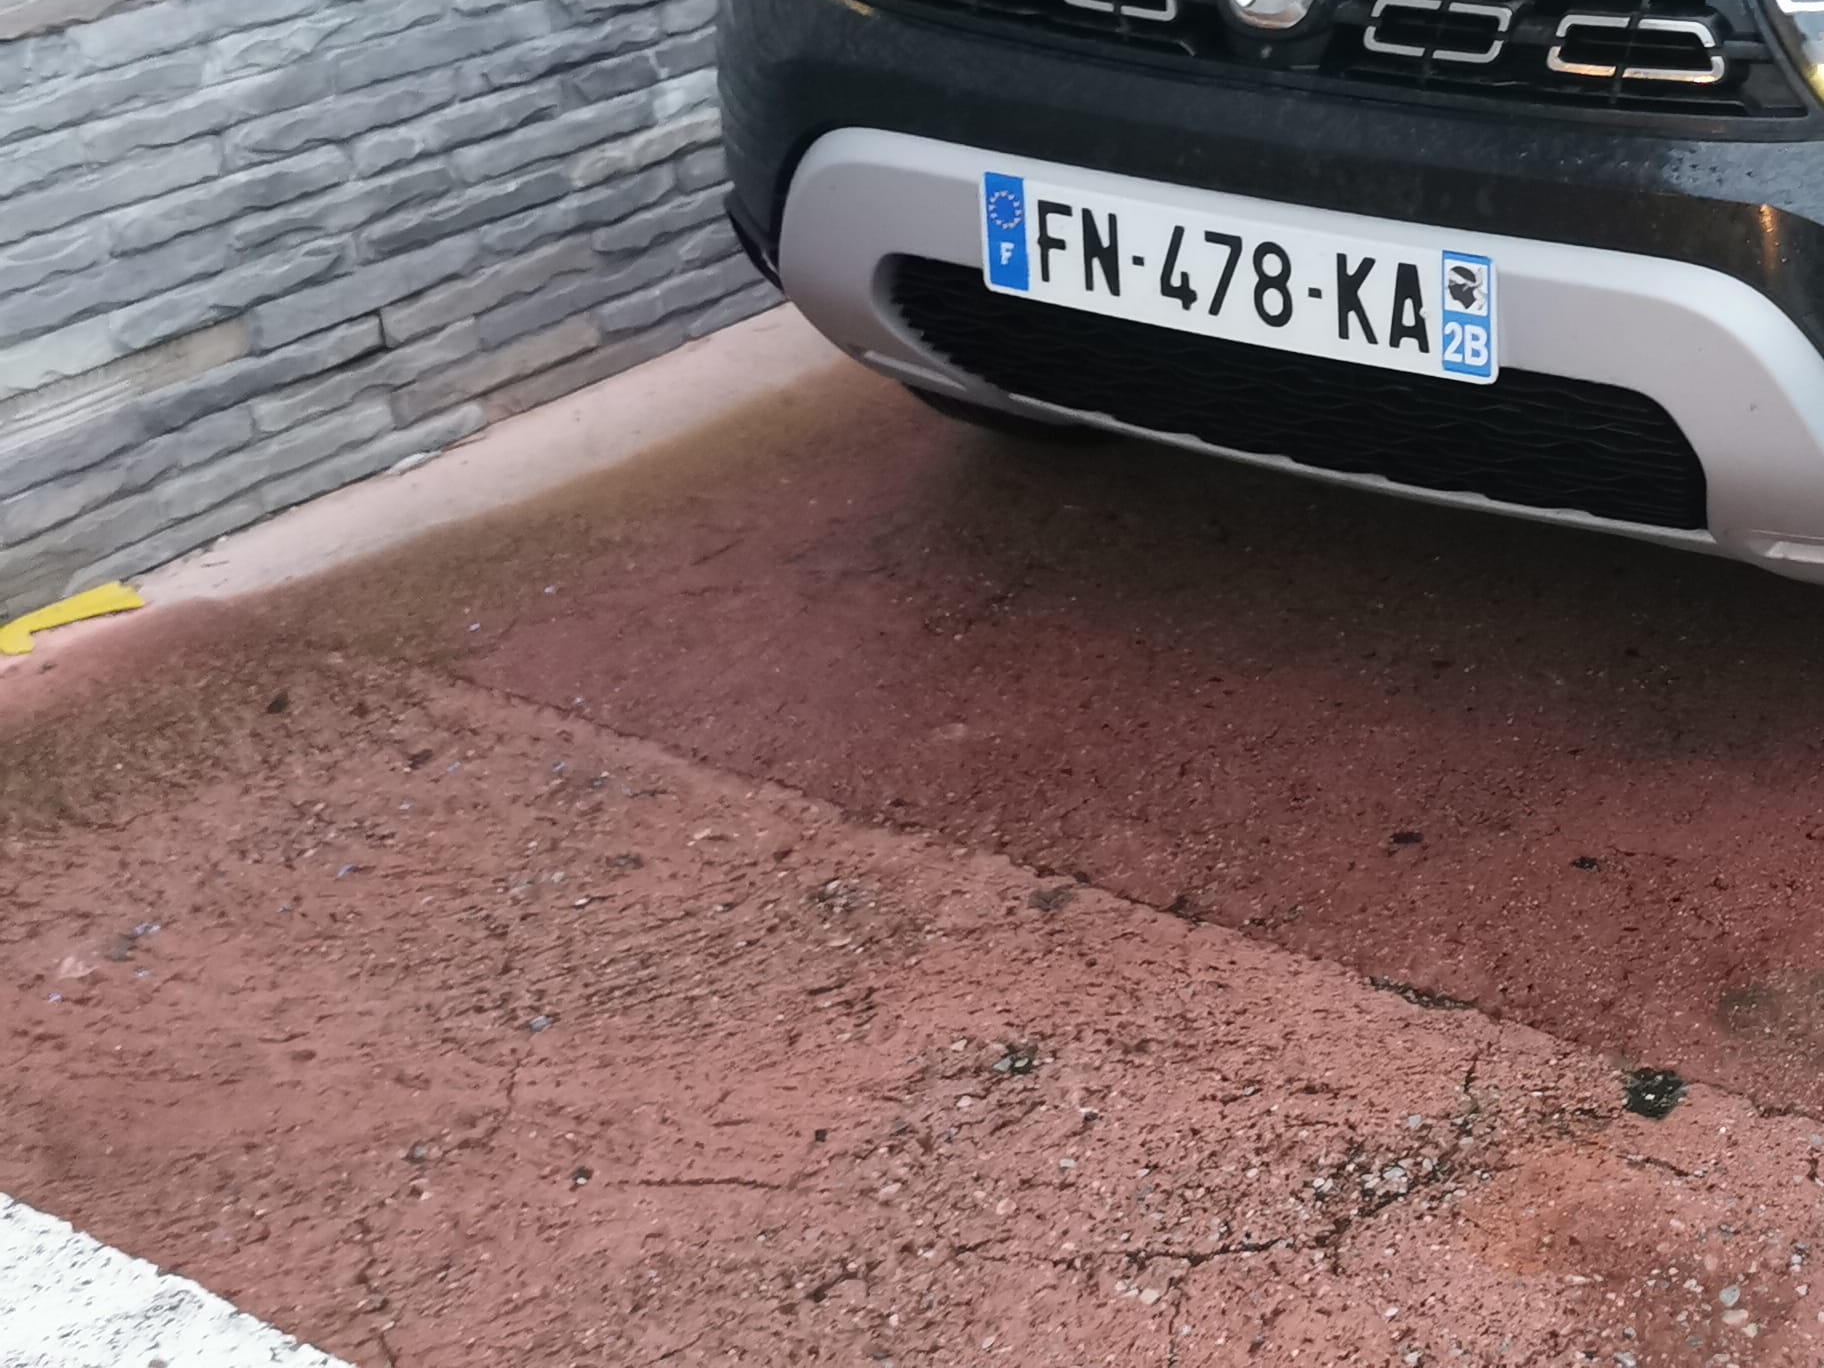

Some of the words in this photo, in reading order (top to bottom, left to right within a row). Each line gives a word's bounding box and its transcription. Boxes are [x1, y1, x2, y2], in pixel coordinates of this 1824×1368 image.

[1000, 241, 1016, 265] F
[1037, 199, 1430, 354] FN-478-KA
[1443, 322, 1489, 368] 2B
